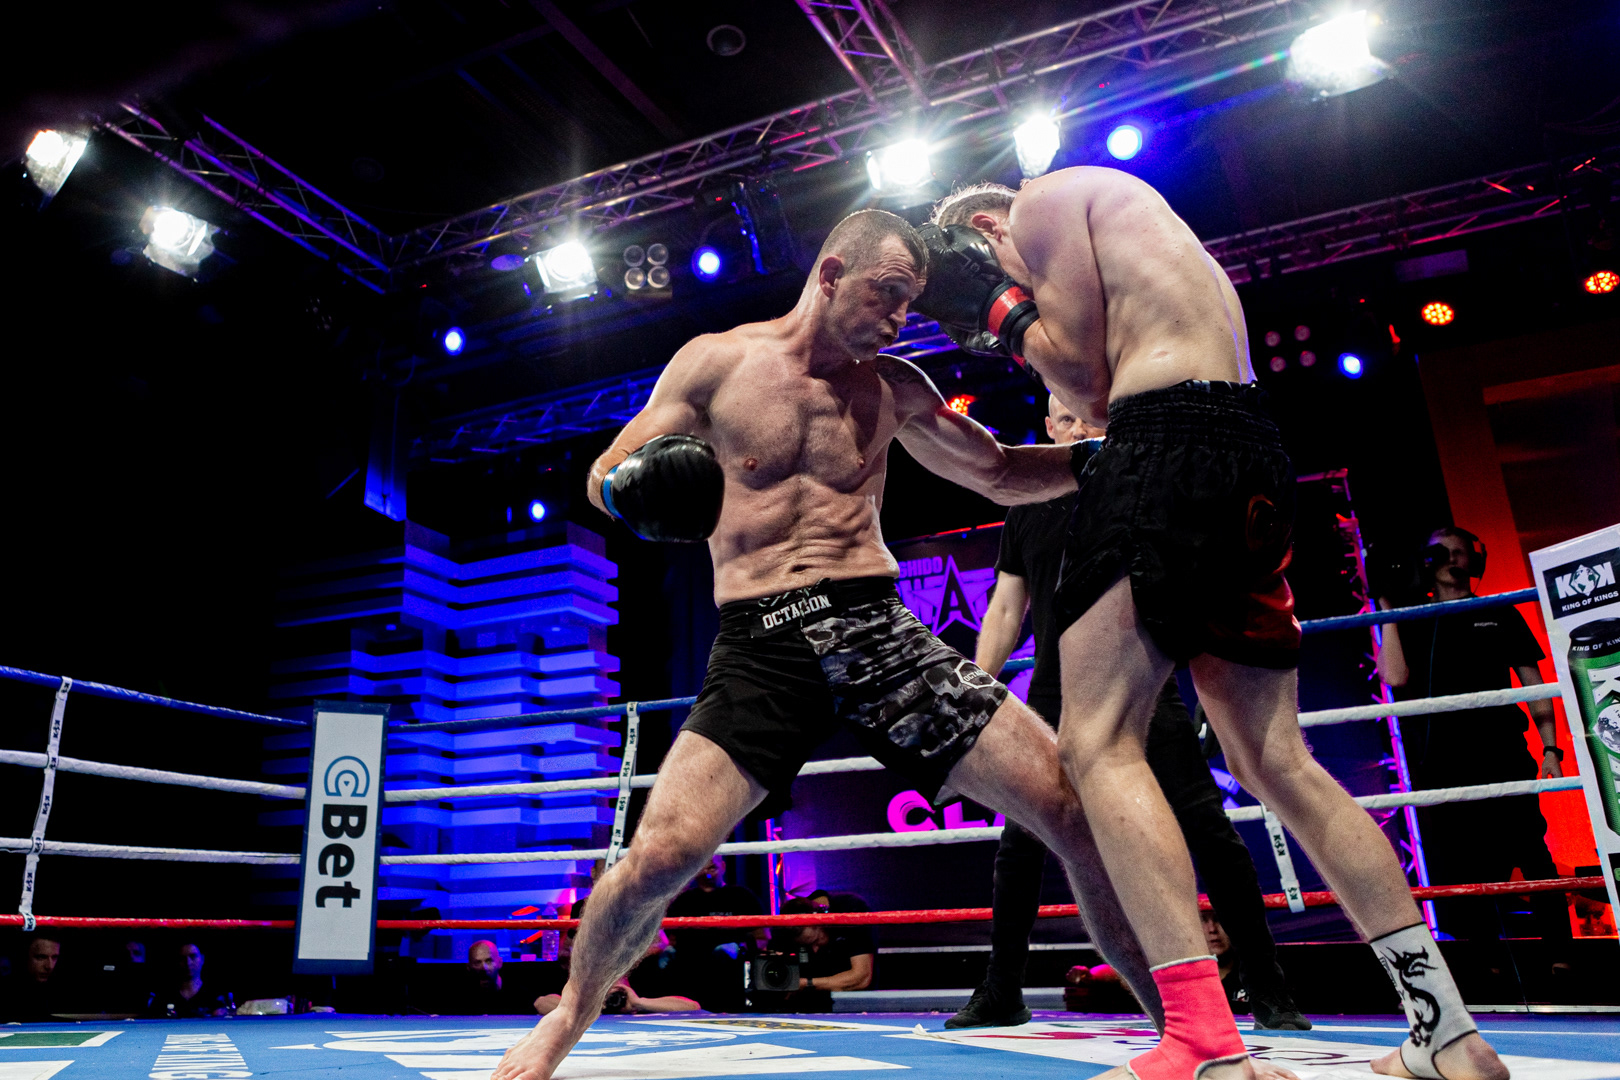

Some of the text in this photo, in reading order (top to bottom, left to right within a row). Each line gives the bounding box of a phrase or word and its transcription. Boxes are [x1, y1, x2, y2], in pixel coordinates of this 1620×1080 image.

[762, 594, 832, 630] OCTAGON
[1561, 590, 1619, 612] KING OF KINGS
[1592, 642, 1603, 650] OF
